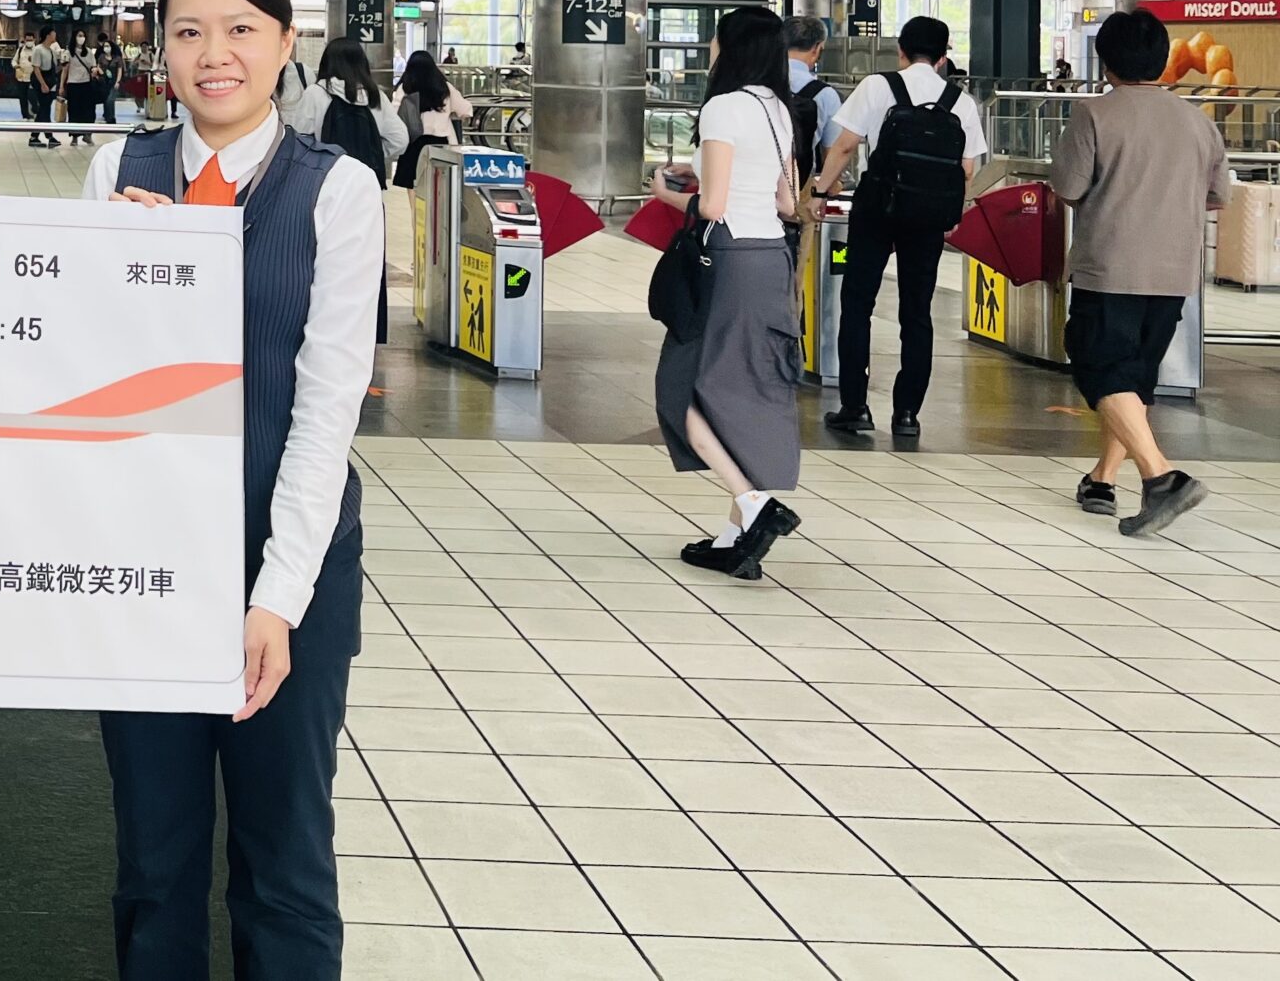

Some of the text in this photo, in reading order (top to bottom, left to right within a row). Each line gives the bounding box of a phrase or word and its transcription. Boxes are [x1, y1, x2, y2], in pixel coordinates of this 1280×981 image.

[608, 9, 623, 18] Car
[1230, 1, 1277, 16] Donut
[348, 14, 374, 25] 7-12
[15, 254, 60, 278] 654
[127, 262, 195, 286] 來回票
